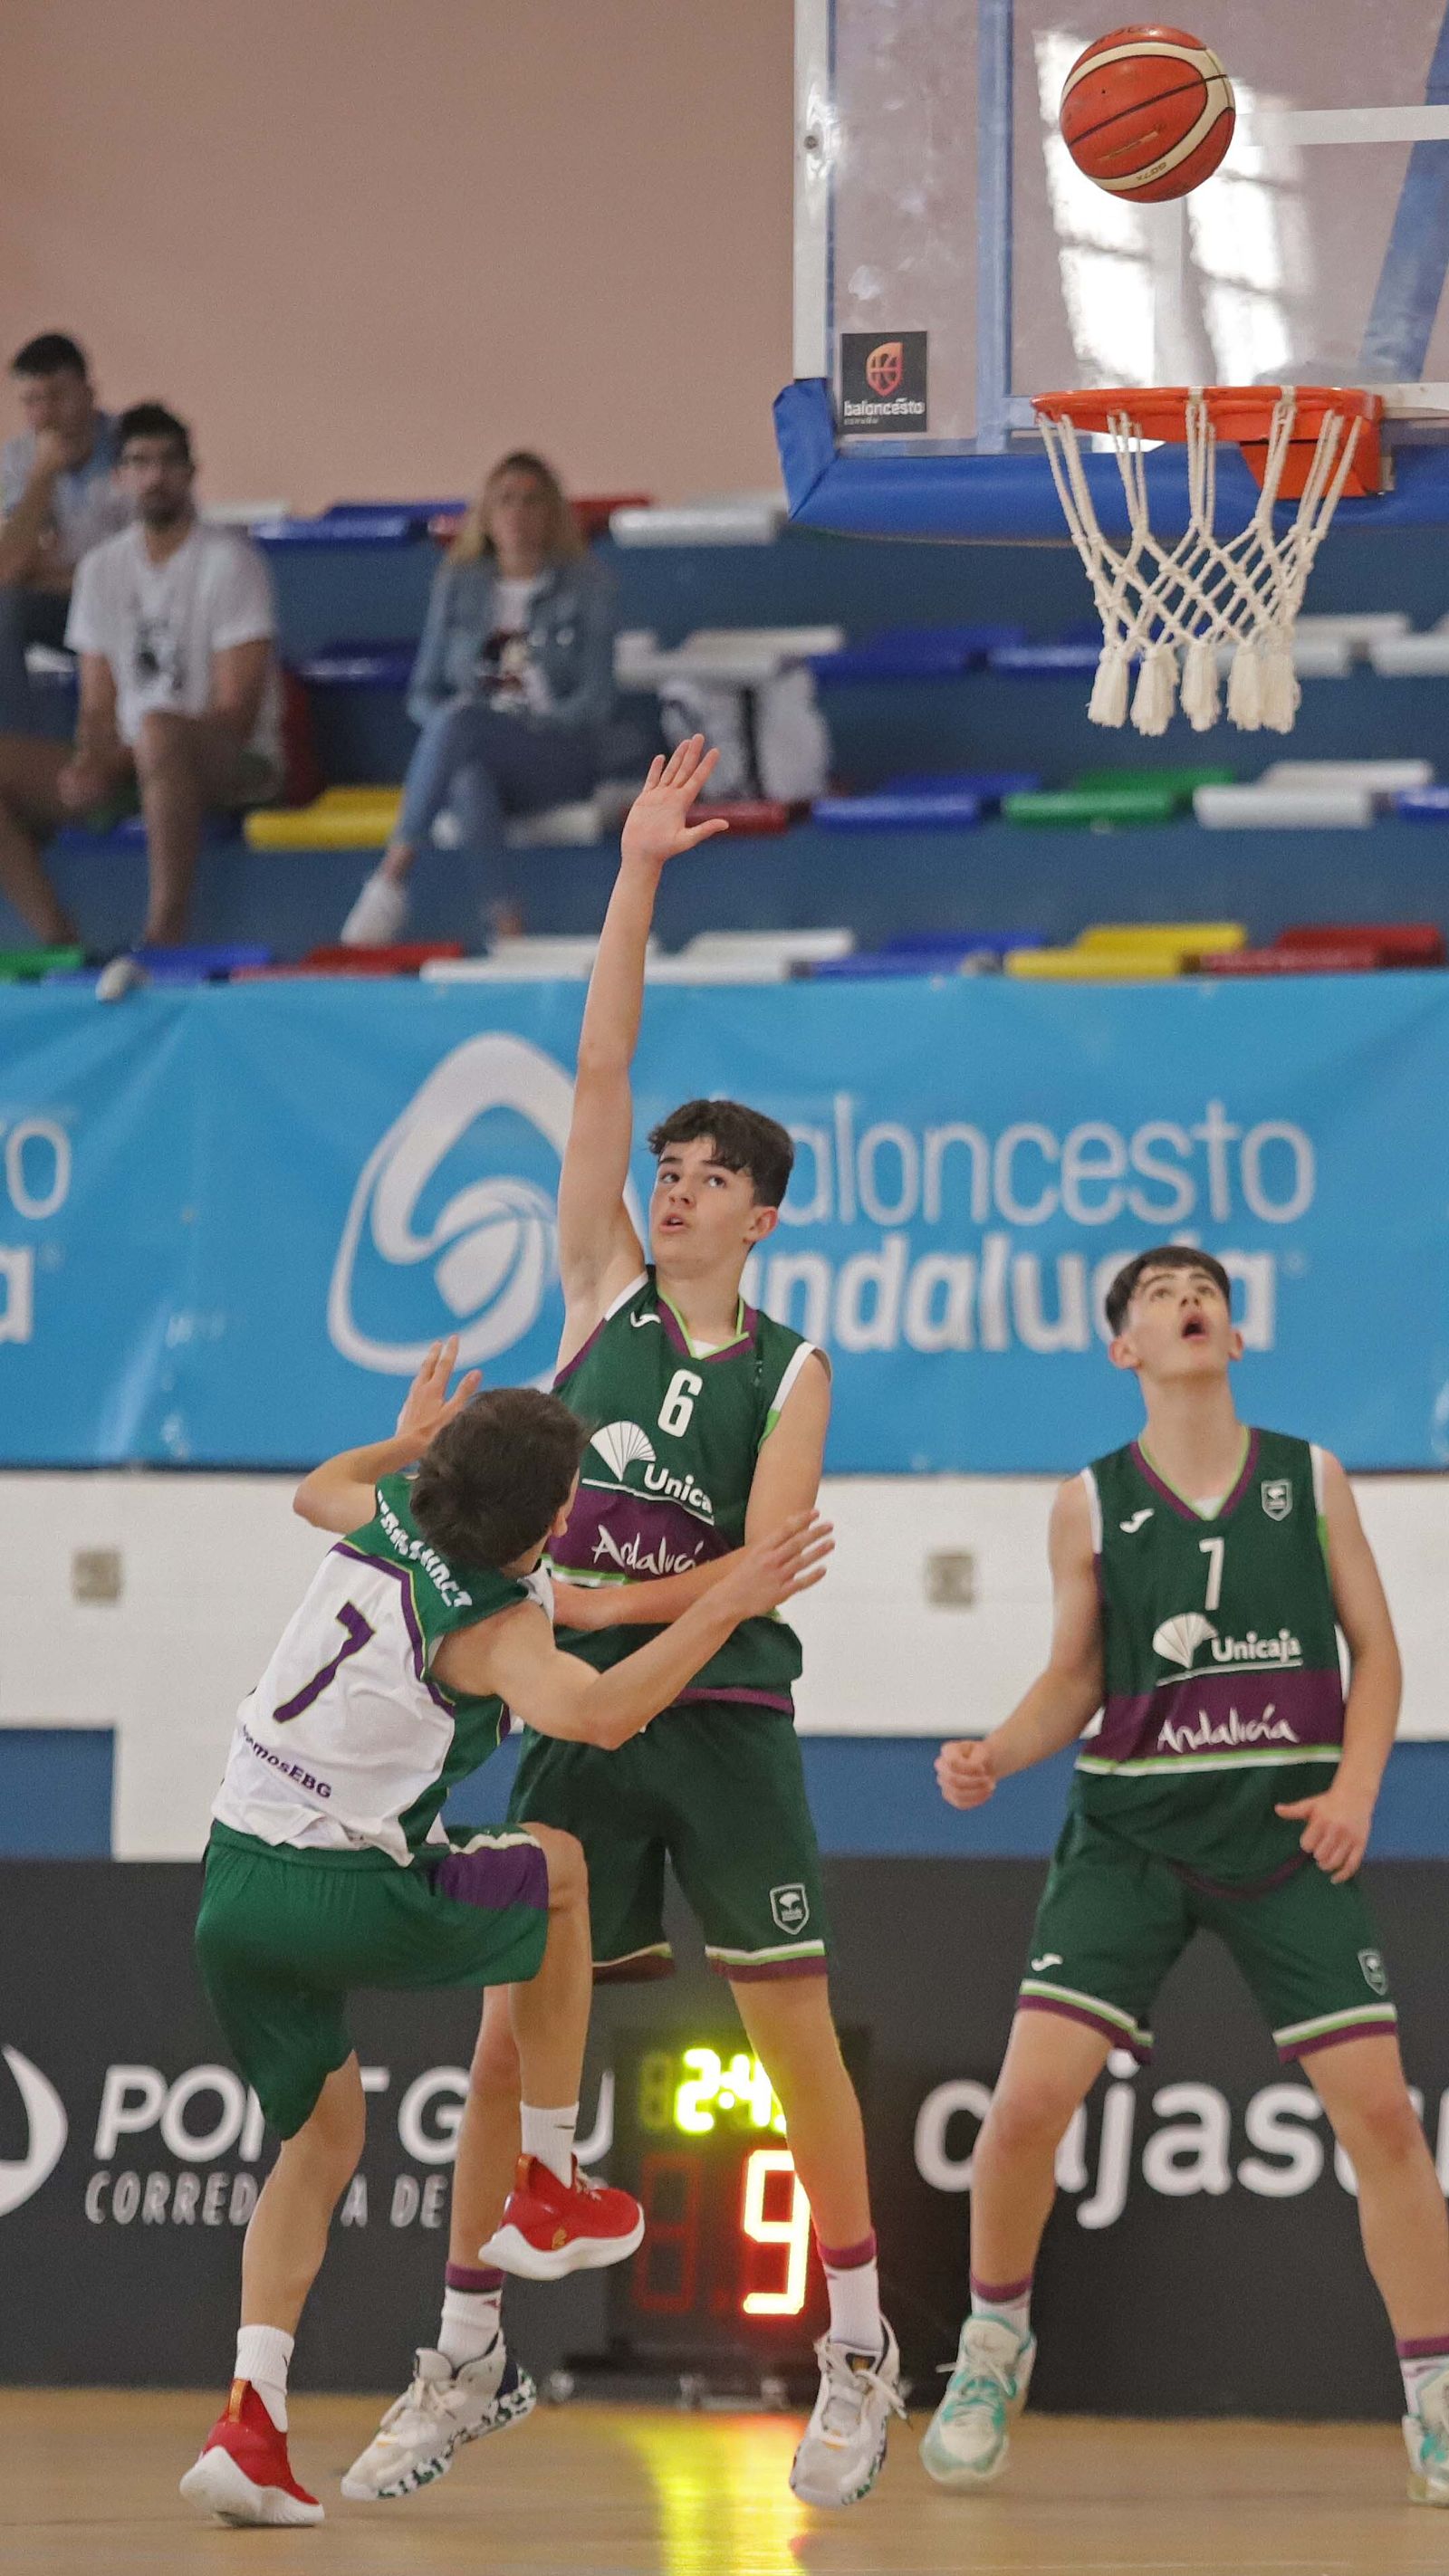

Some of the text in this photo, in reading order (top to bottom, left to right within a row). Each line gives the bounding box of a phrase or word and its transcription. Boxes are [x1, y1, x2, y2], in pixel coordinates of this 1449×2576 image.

[843, 397, 926, 417] baloncesto
[709, 1091, 1317, 1226] aloncesto
[738, 1230, 1276, 1353] ndalua
[657, 1368, 703, 1438] 6
[643, 1462, 714, 1517] Unica
[1198, 1537, 1224, 1611] 7
[272, 1601, 376, 1724] 7
[1211, 1628, 1302, 1663] Unicaja
[1156, 1703, 1300, 1754] Andalucía
[675, 2047, 786, 2134] 2:4
[914, 2047, 1449, 2229] cjas
[85, 2170, 447, 2228] CORREDA DE
[743, 2149, 811, 2314] 9
